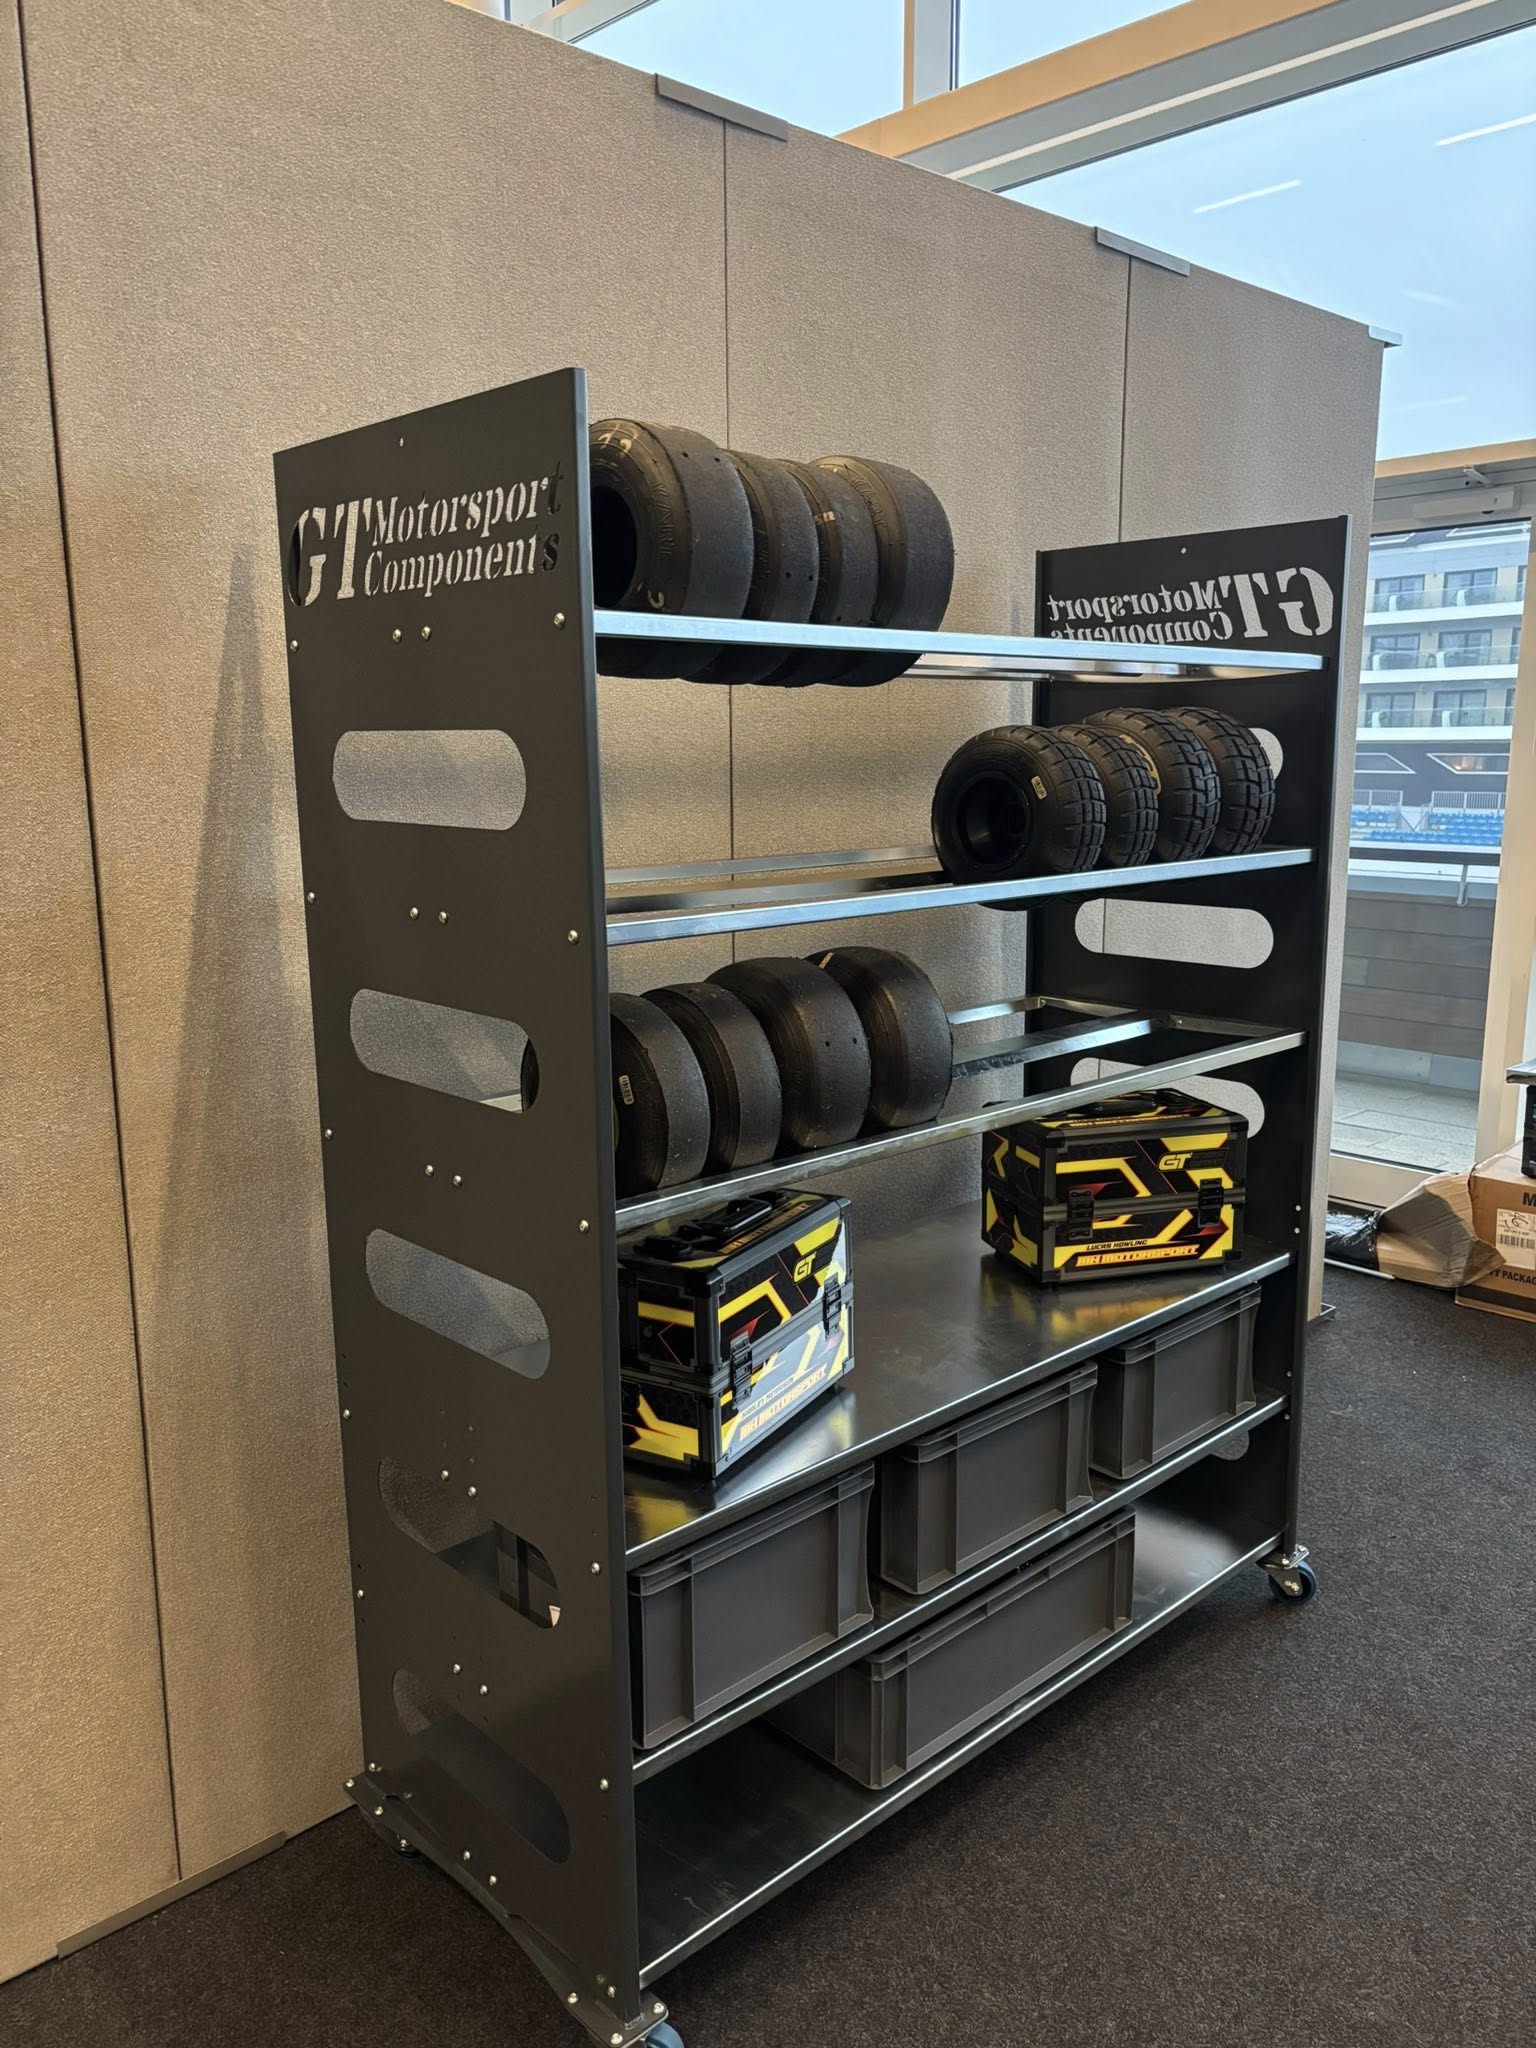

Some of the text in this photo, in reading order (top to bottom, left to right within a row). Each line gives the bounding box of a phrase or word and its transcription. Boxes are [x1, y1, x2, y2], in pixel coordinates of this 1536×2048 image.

[287, 461, 564, 607] GT Motorsport
[363, 526, 560, 598] Components
[1158, 1152, 1193, 1170] GT
[1086, 1243, 1111, 1251] LUCAS
[793, 1251, 817, 1283] GT
